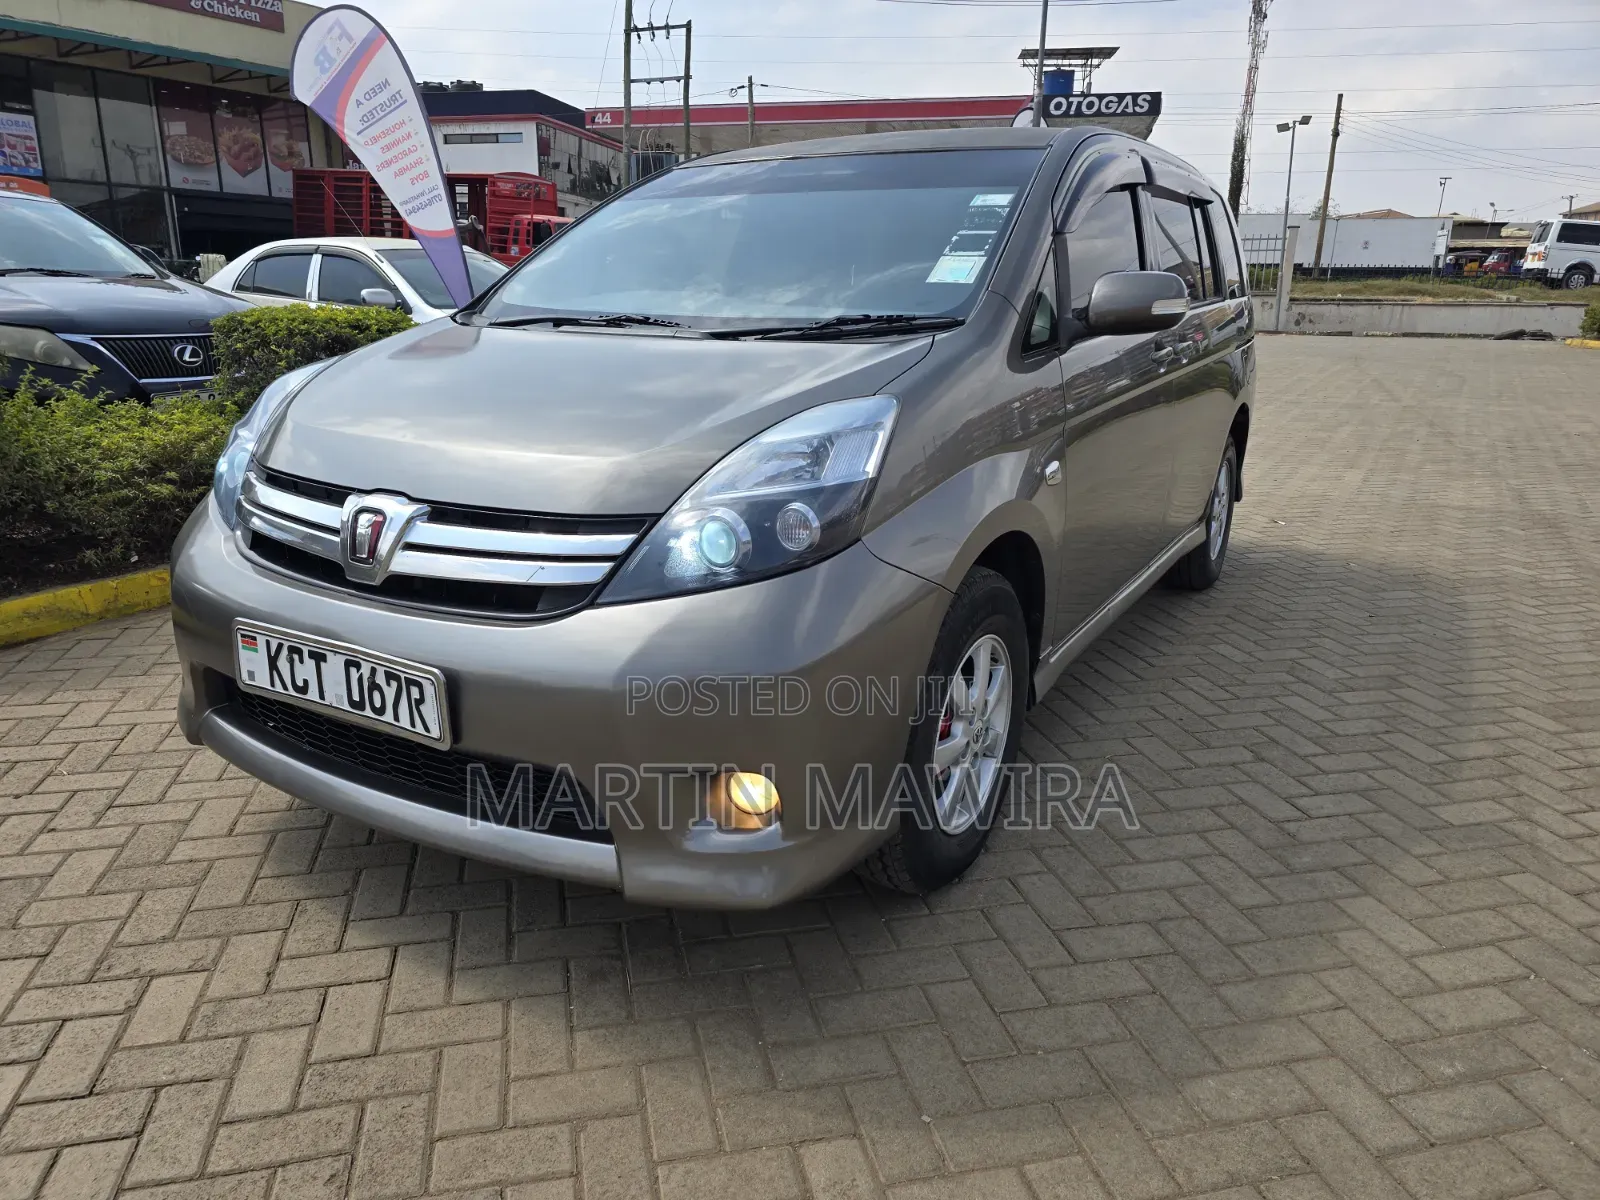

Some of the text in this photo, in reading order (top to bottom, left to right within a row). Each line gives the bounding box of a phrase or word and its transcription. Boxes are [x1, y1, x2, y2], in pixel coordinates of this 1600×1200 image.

[202, 0, 261, 22] Chicken
[1049, 94, 1152, 116] OTOGAS
[594, 112, 611, 124] 44
[265, 638, 328, 701] KCT
[343, 658, 431, 734] 067R
